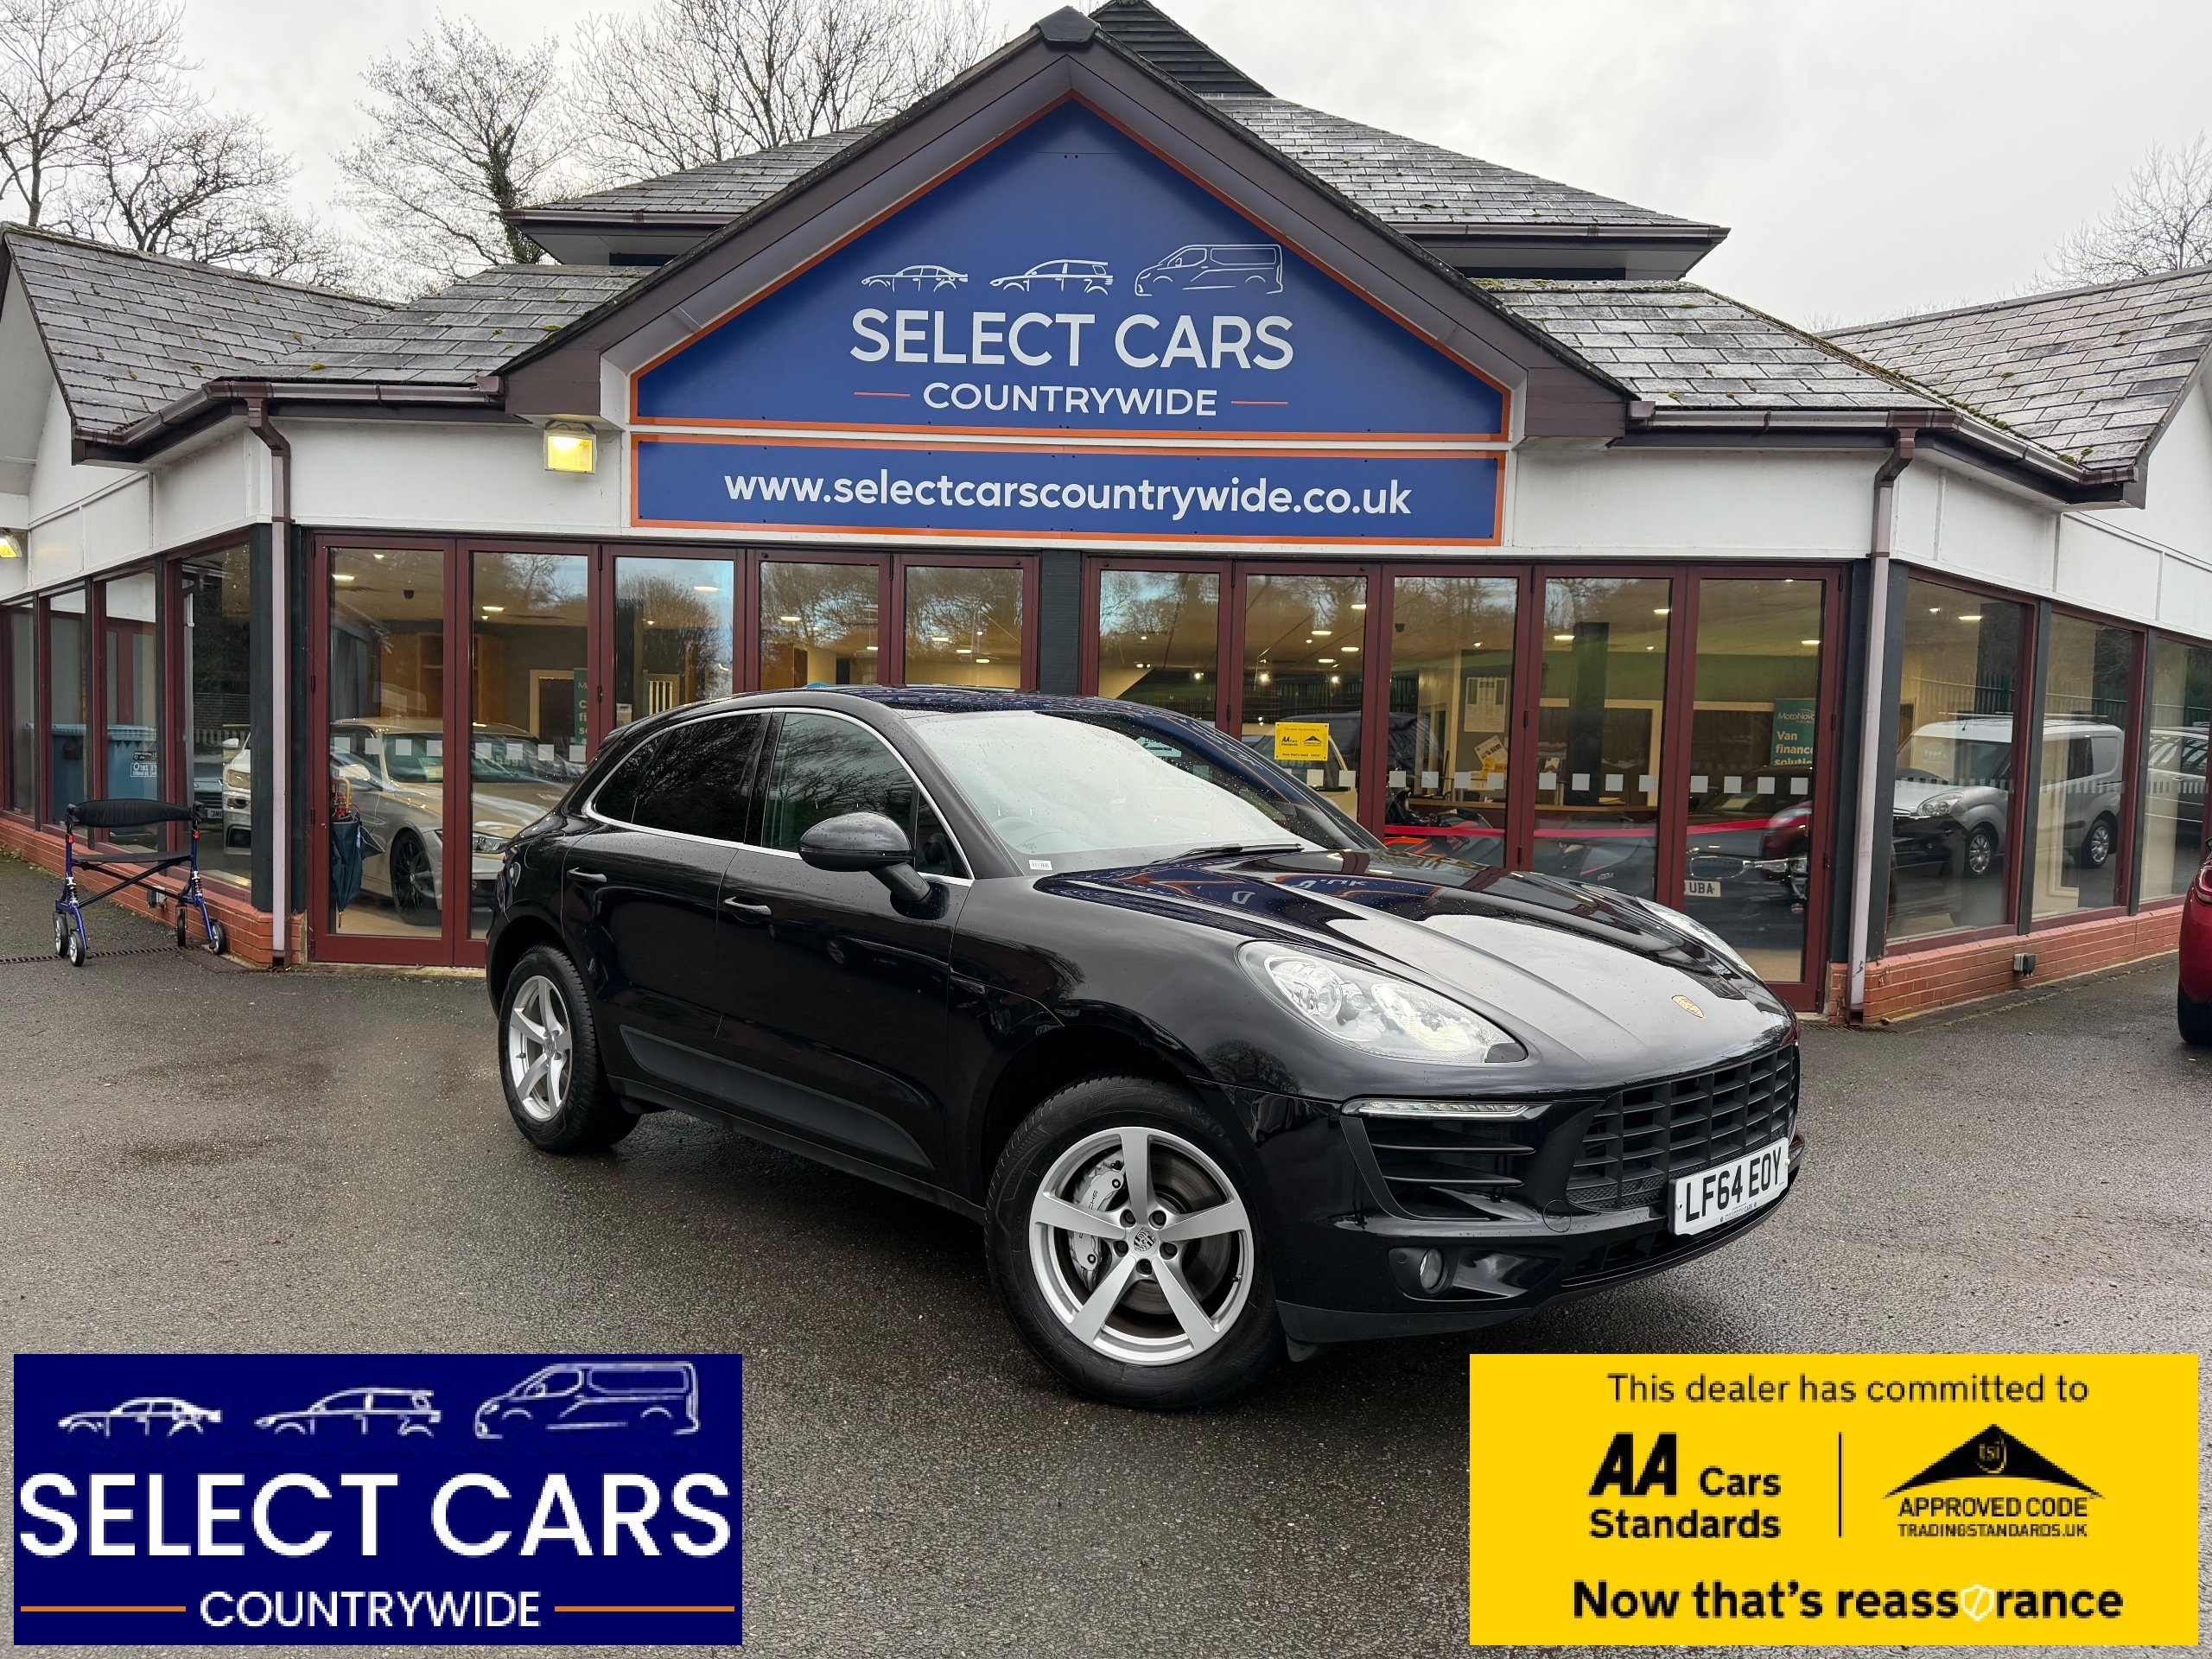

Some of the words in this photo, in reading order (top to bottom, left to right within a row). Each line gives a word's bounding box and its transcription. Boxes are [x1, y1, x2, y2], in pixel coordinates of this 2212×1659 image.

[849, 308, 1096, 366] SELECT
[1115, 314, 1294, 370] CARS
[923, 382, 1217, 416] COUNTRYWIDE
[724, 468, 1412, 521] www.selectcarscountrywide.co.uk
[1777, 731, 1797, 741] Van
[1689, 882, 1713, 894] UBA
[1686, 1164, 1744, 1224] LF64
[1749, 1146, 1782, 1198] EOY
